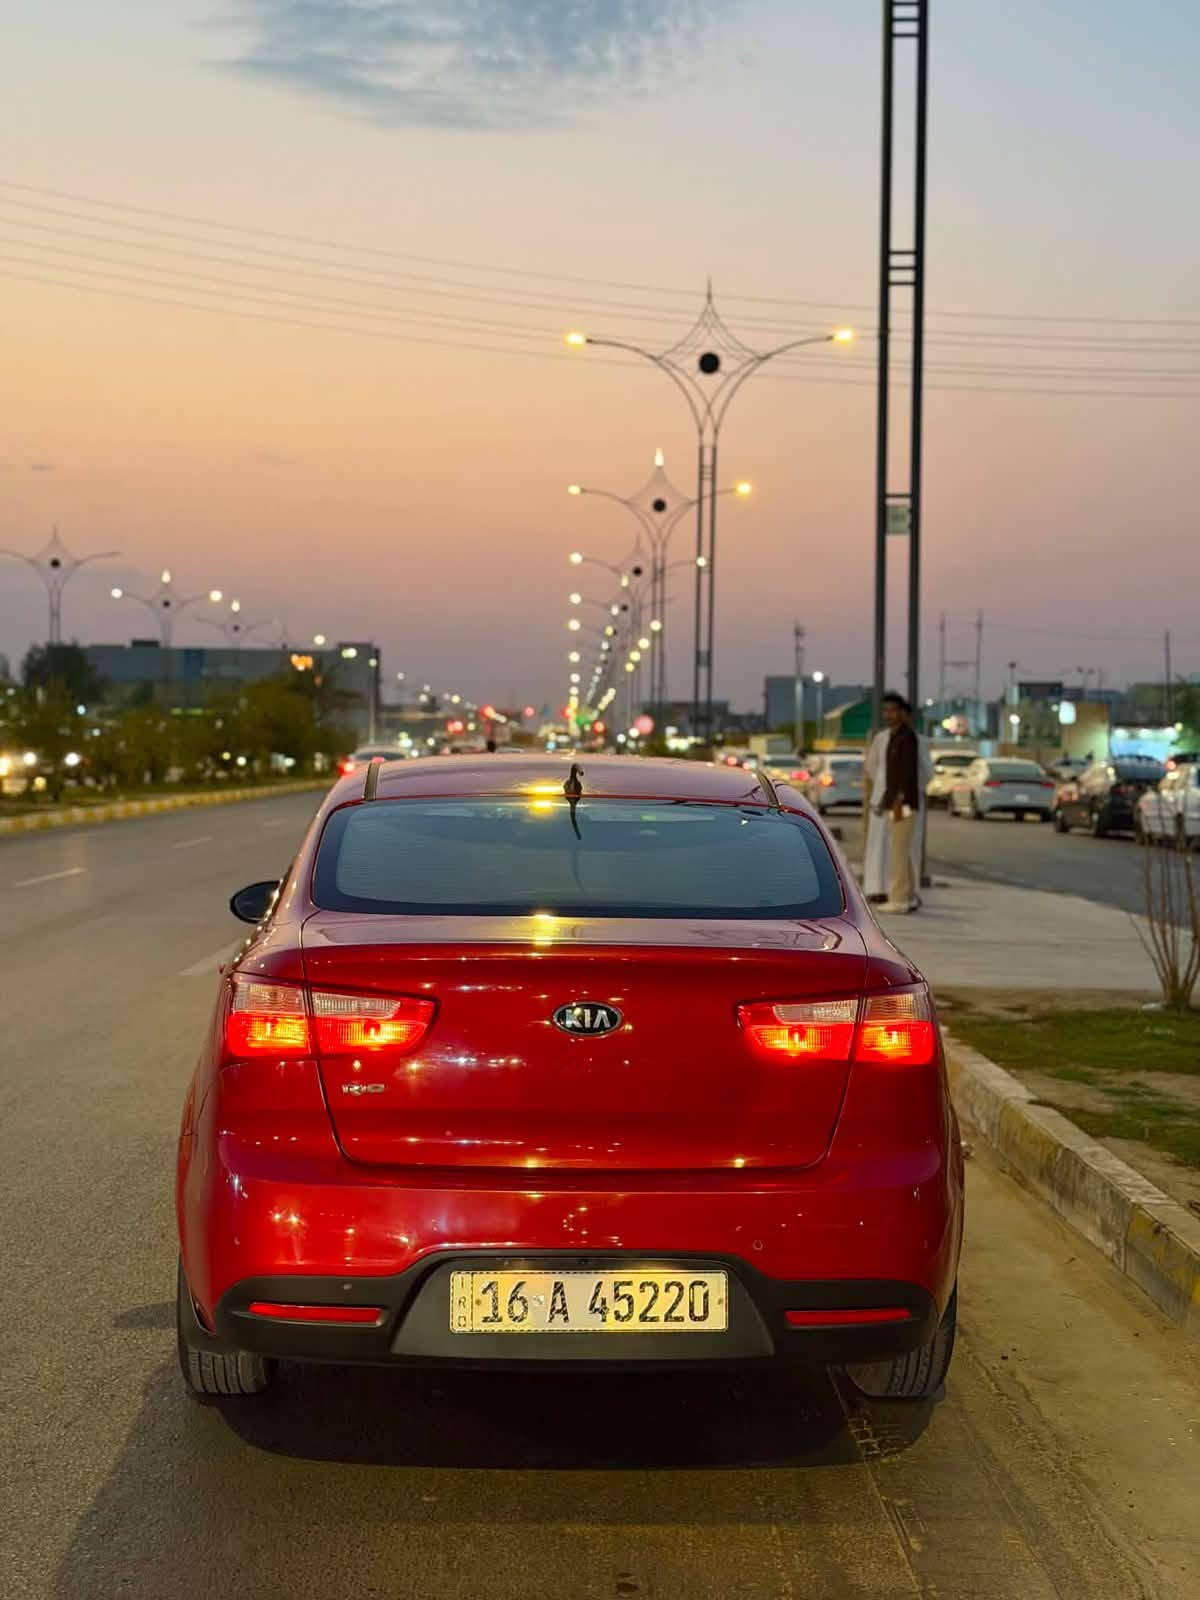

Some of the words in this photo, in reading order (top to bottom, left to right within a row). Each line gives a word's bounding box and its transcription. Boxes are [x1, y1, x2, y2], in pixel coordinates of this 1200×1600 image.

[565, 1008, 611, 1028] KIA
[481, 1280, 529, 1323] 16
[547, 1280, 569, 1323] A
[588, 1280, 710, 1323] 45220
